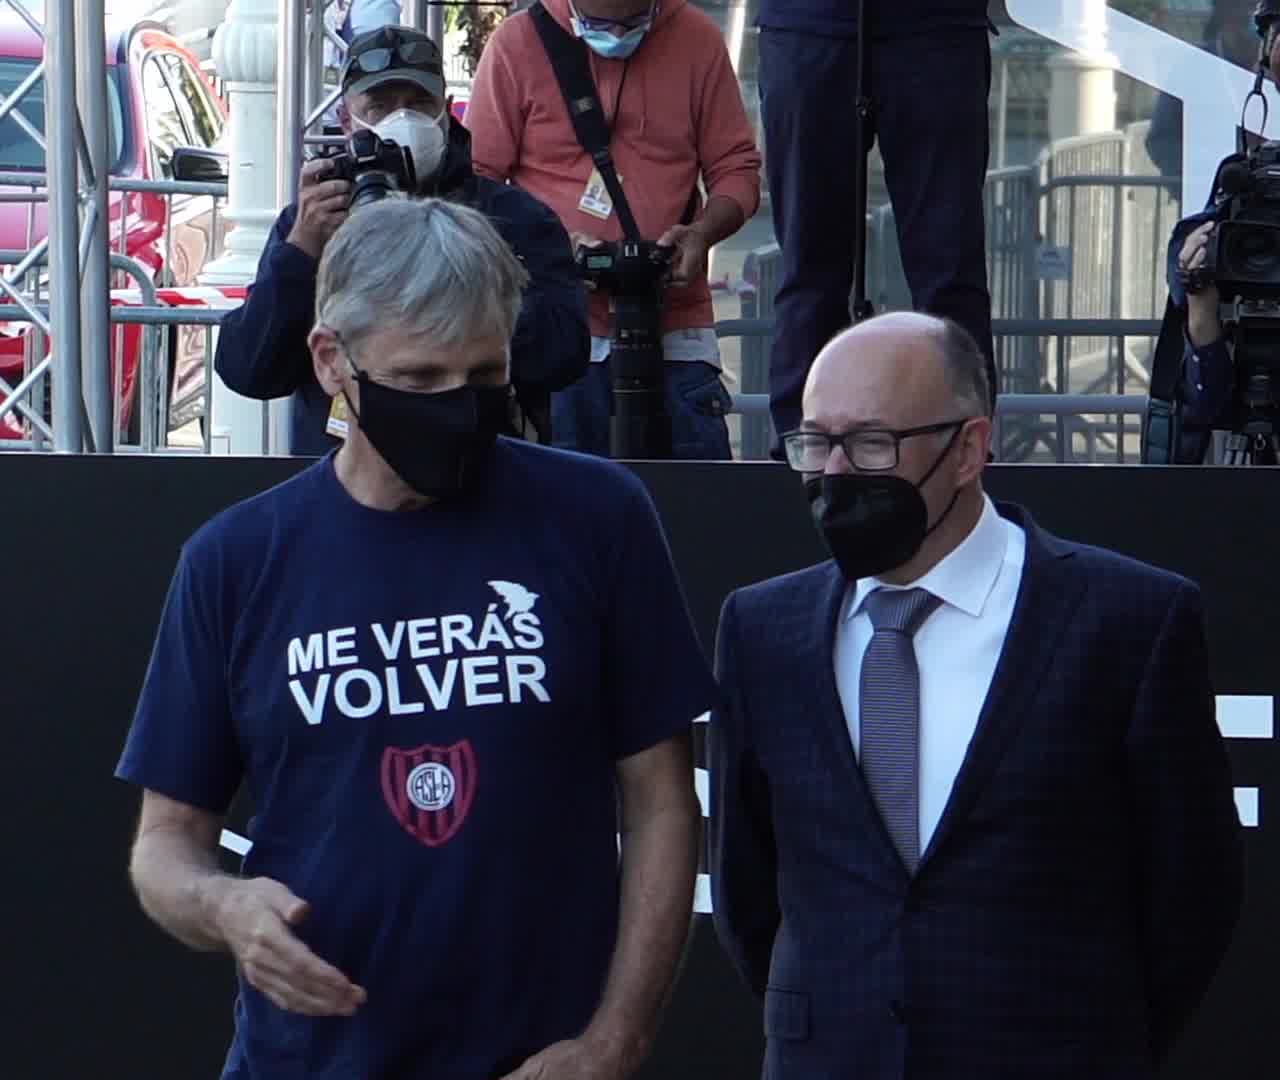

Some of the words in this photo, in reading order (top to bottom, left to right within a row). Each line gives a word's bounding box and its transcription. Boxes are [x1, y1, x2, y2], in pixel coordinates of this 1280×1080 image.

[287, 626, 358, 676] ME
[371, 603, 545, 661] VERÁS
[288, 655, 552, 726] VOLVER
